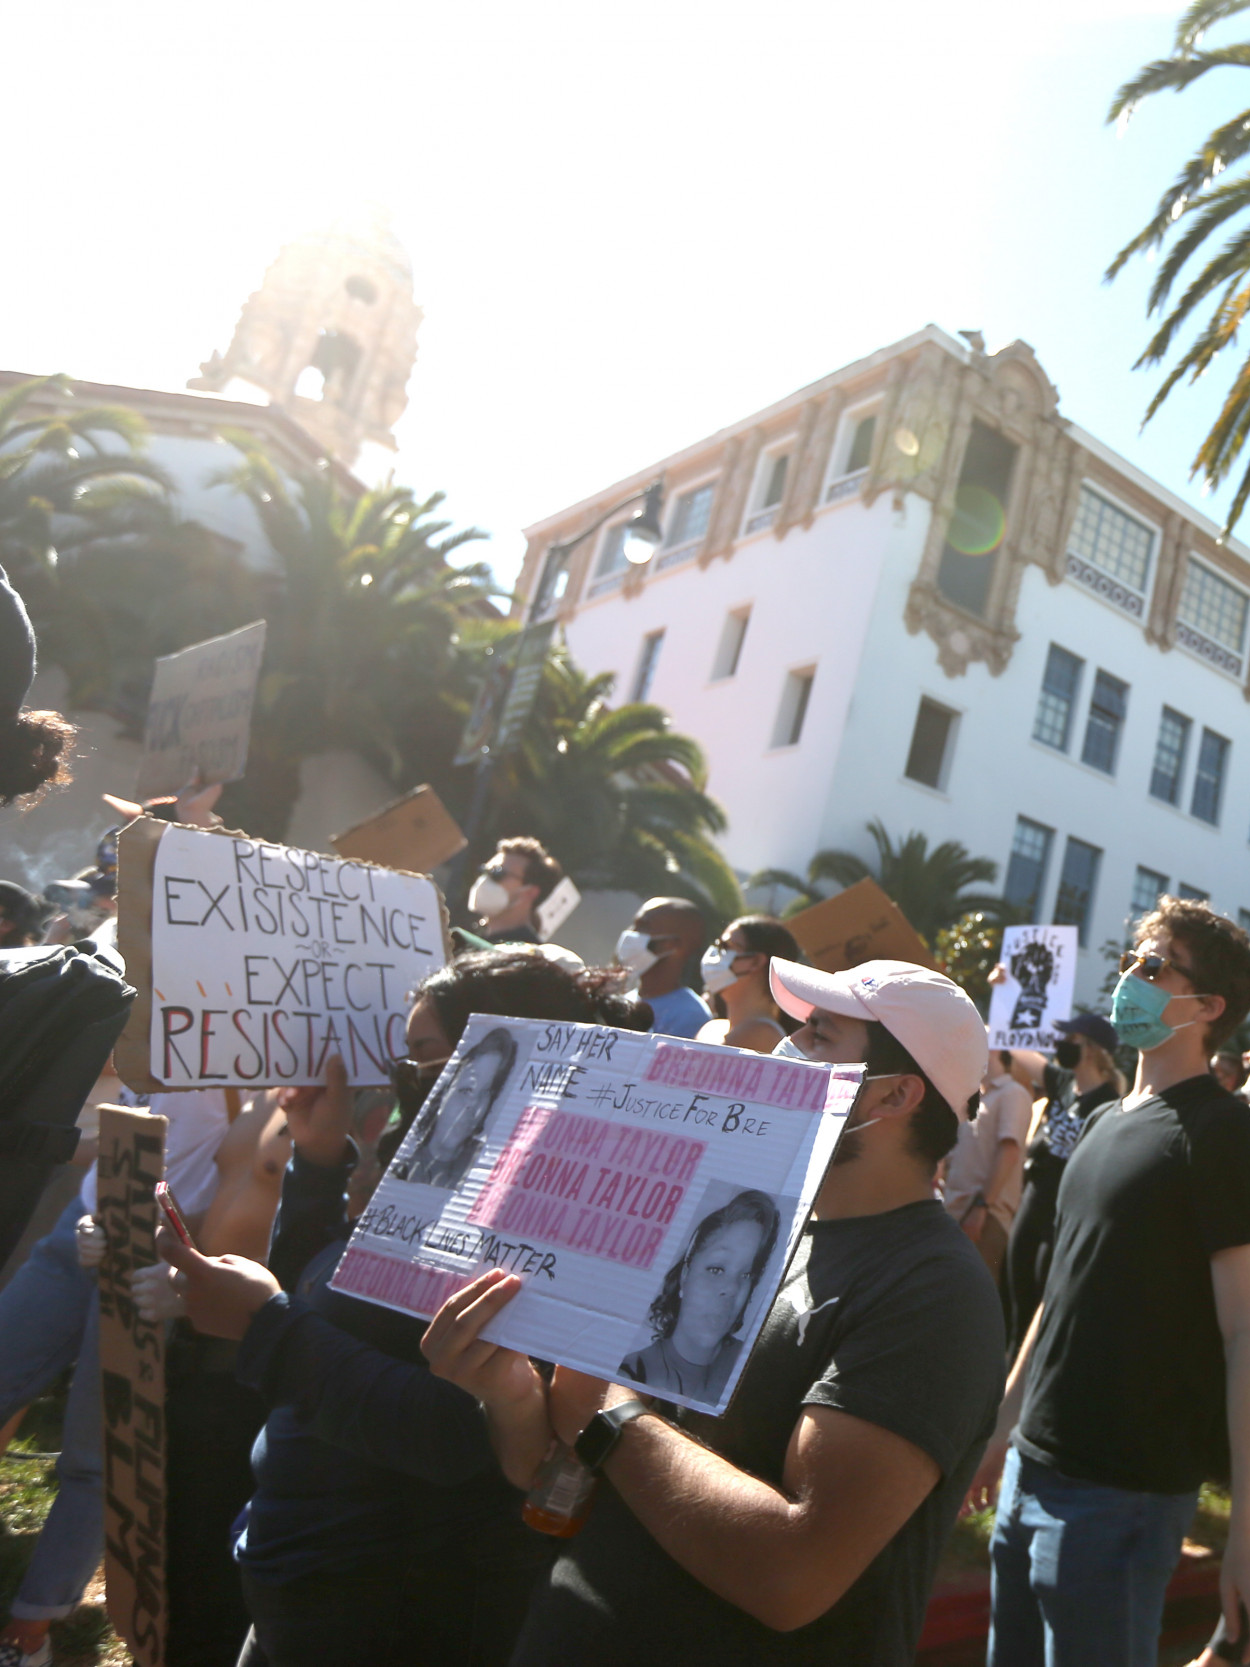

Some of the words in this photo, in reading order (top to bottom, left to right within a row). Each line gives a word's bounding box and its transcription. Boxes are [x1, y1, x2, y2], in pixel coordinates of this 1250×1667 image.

[232, 839, 379, 903] RESPECT
[164, 876, 433, 956] EXISISTENCE
[244, 955, 396, 1012] EXPECT
[160, 1005, 409, 1080] RESISTANC
[537, 1024, 574, 1052] SAY
[578, 1029, 619, 1062] HER
[646, 1043, 765, 1100] BREONNA
[519, 1060, 589, 1099] NAME
[609, 1126, 707, 1182] TAYLOR
[488, 1147, 591, 1201] BREONNA
[587, 1167, 684, 1225] TAYLOR
[565, 1208, 665, 1269] TAYLOR
[104, 1367, 136, 1579] BLM
[132, 1392, 164, 1666] FILIPINOS
